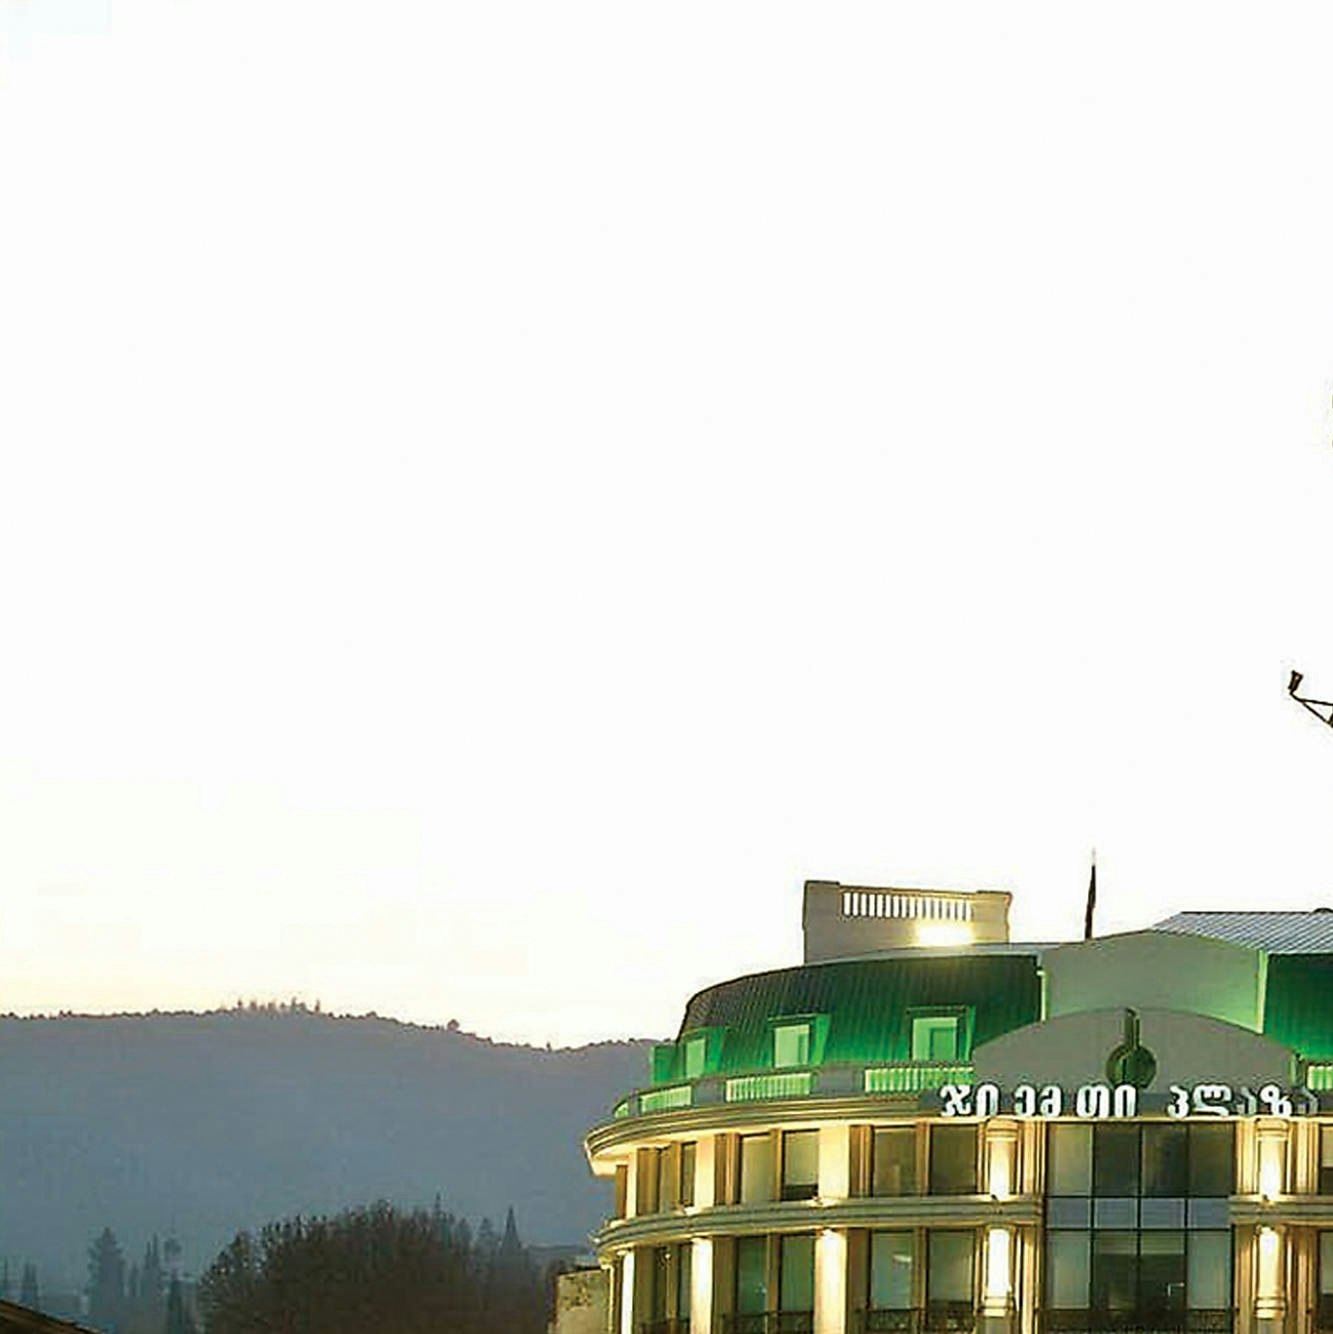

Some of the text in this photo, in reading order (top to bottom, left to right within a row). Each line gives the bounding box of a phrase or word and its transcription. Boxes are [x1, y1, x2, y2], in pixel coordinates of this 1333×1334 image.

[939, 1083, 1320, 1117] ჯი ემ თი პლაზა
